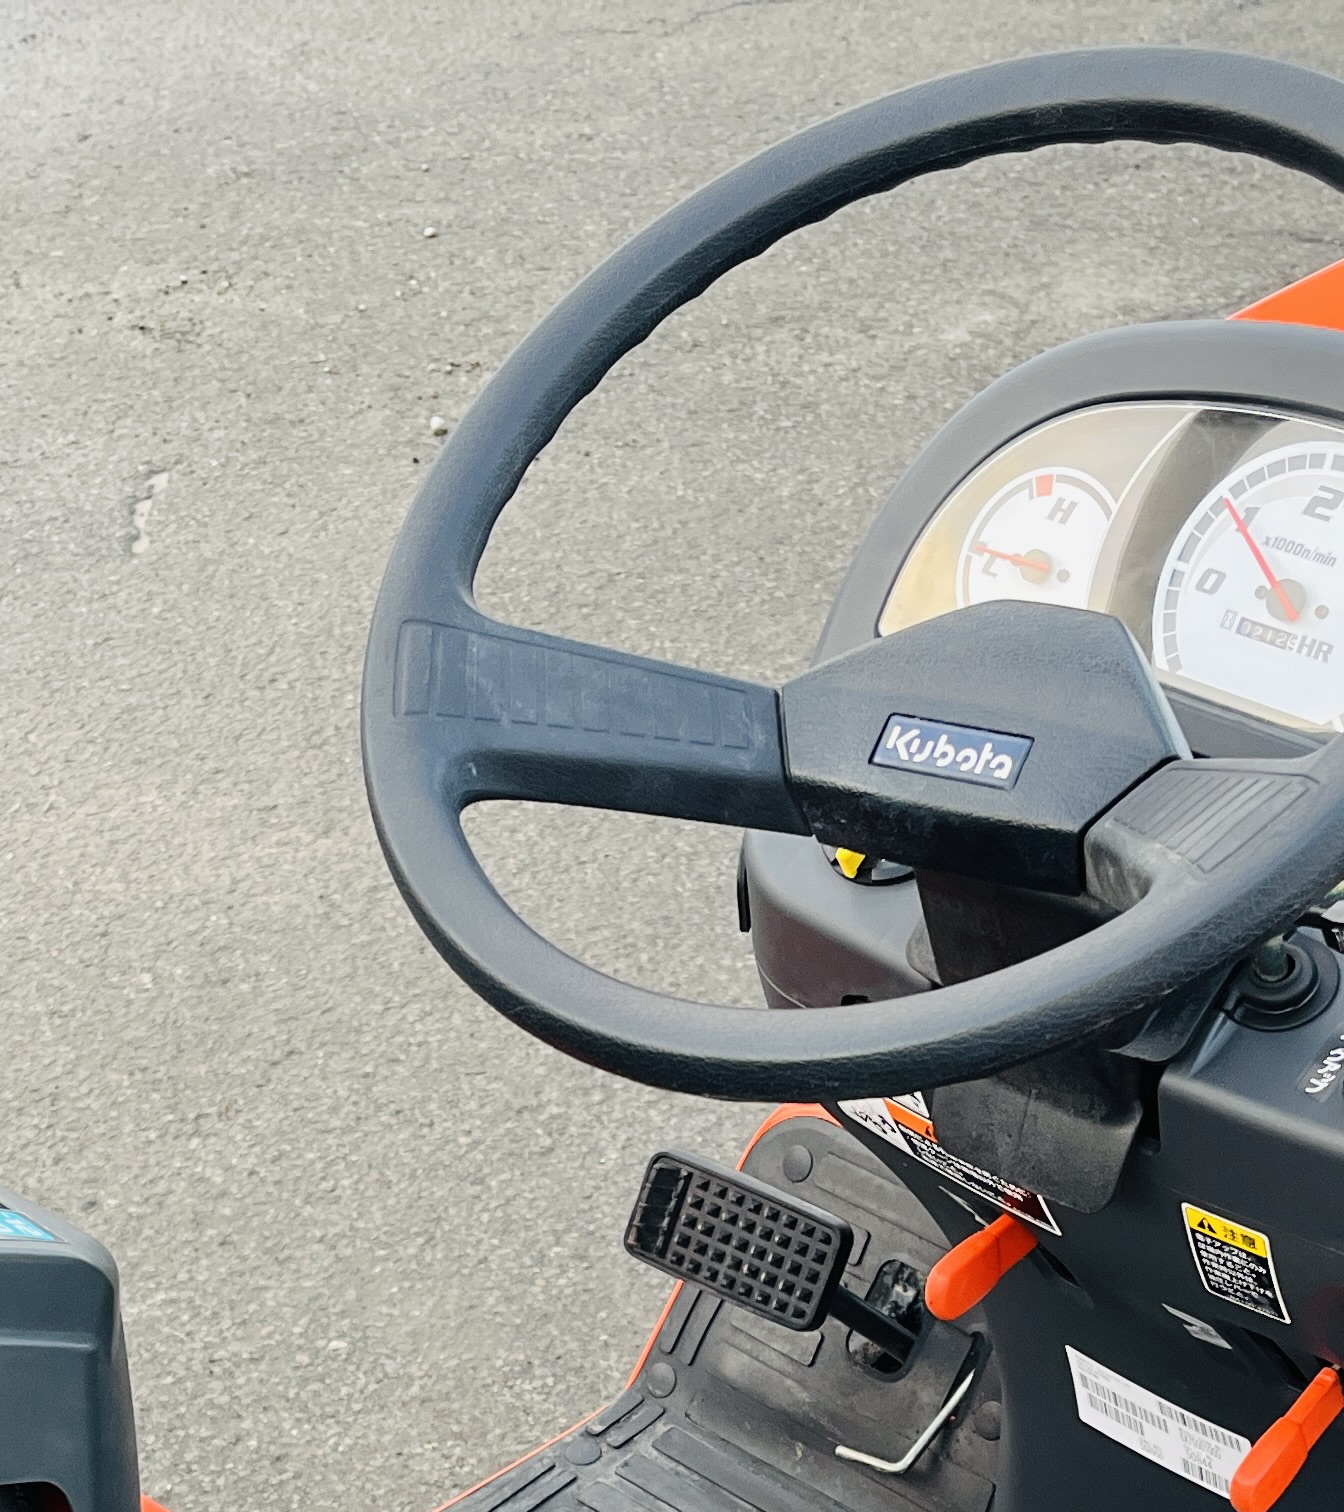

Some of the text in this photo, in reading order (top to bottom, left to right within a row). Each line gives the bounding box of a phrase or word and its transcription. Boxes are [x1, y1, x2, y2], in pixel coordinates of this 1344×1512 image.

[1047, 497, 1078, 525] H
[1196, 568, 1227, 595] 0
[1236, 506, 1261, 535] 1
[1296, 635, 1334, 663] HR
[885, 724, 1014, 781] Kubota
[1220, 1225, 1260, 1250] 注意
